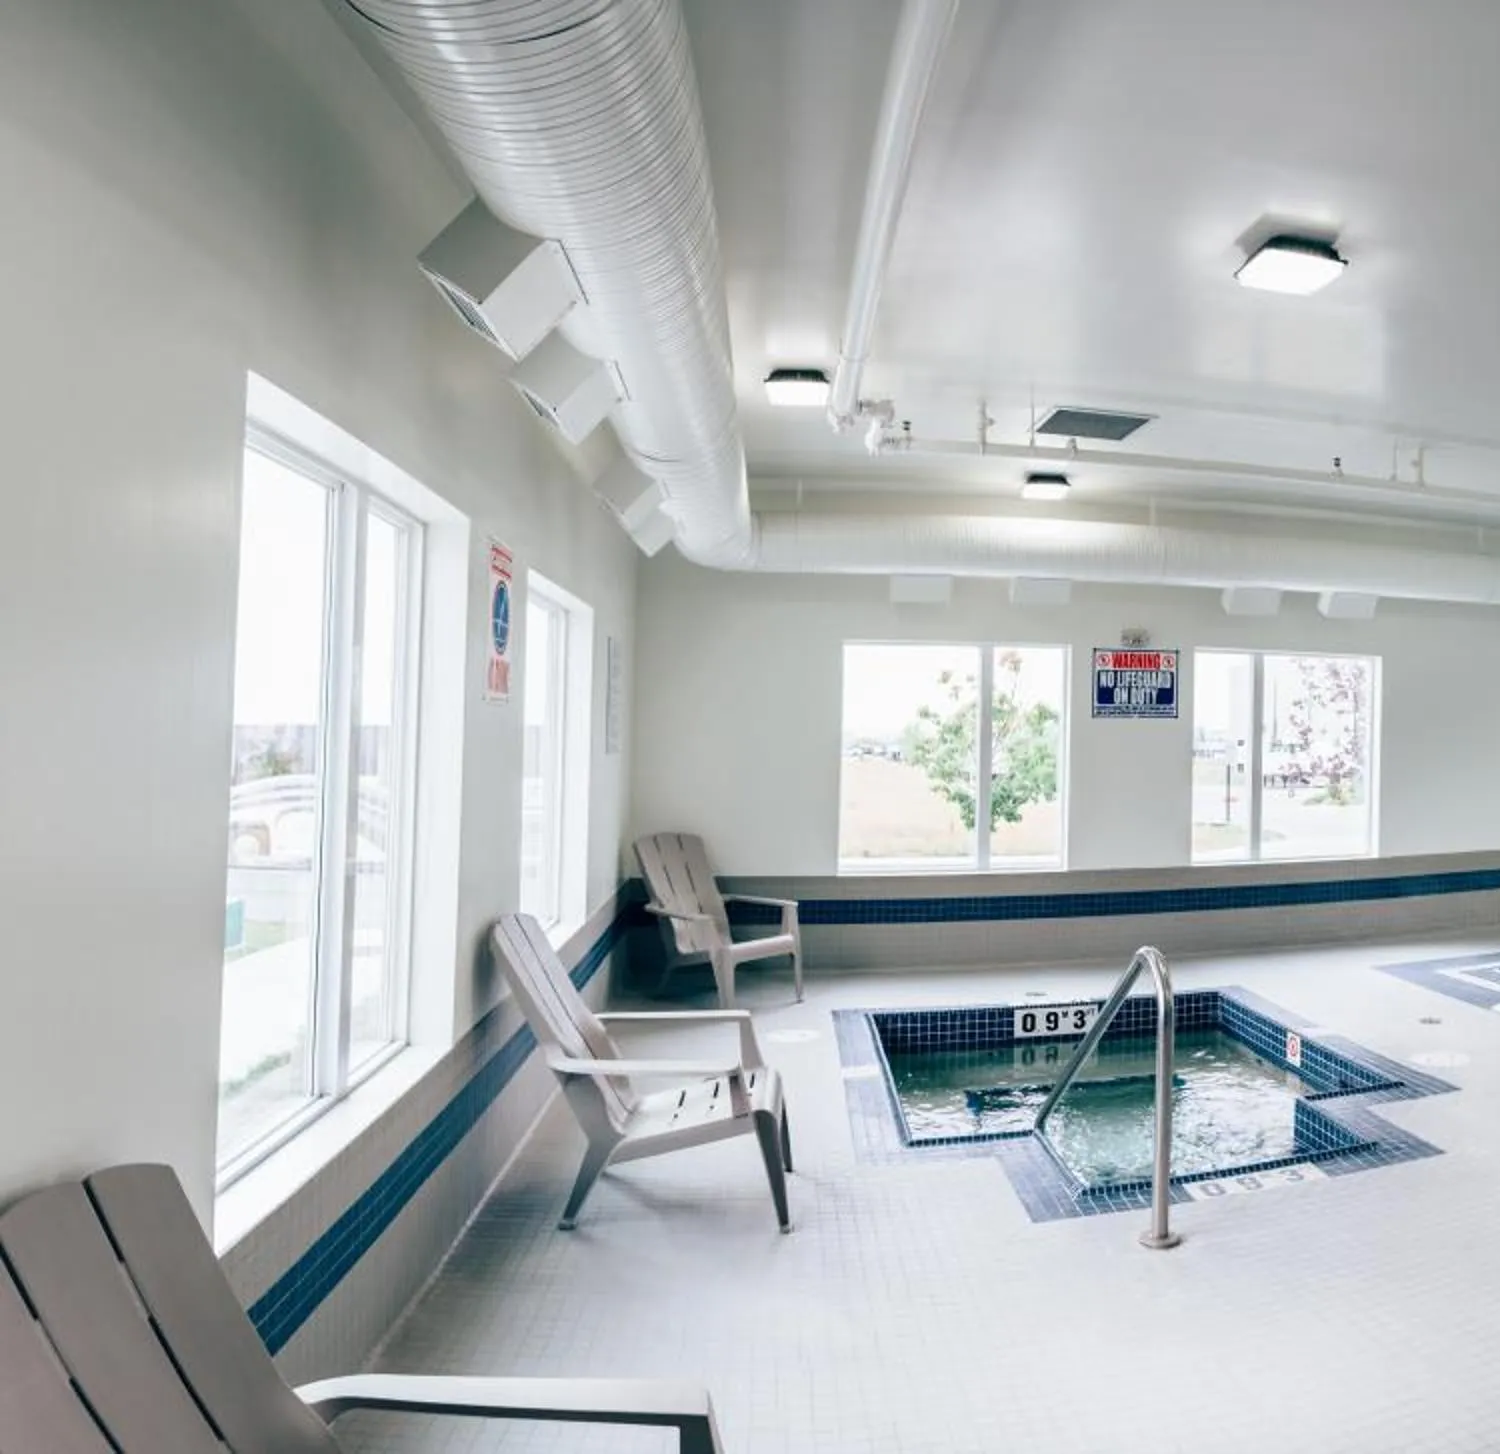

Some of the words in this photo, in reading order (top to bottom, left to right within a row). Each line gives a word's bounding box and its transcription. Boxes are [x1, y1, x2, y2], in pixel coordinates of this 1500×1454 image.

[1111, 652, 1161, 669] WARNING
[1100, 671, 1115, 688] NO
[1118, 671, 1171, 688] LIFEGUARD
[1113, 687, 1129, 704] ON
[1131, 687, 1158, 705] DUTY
